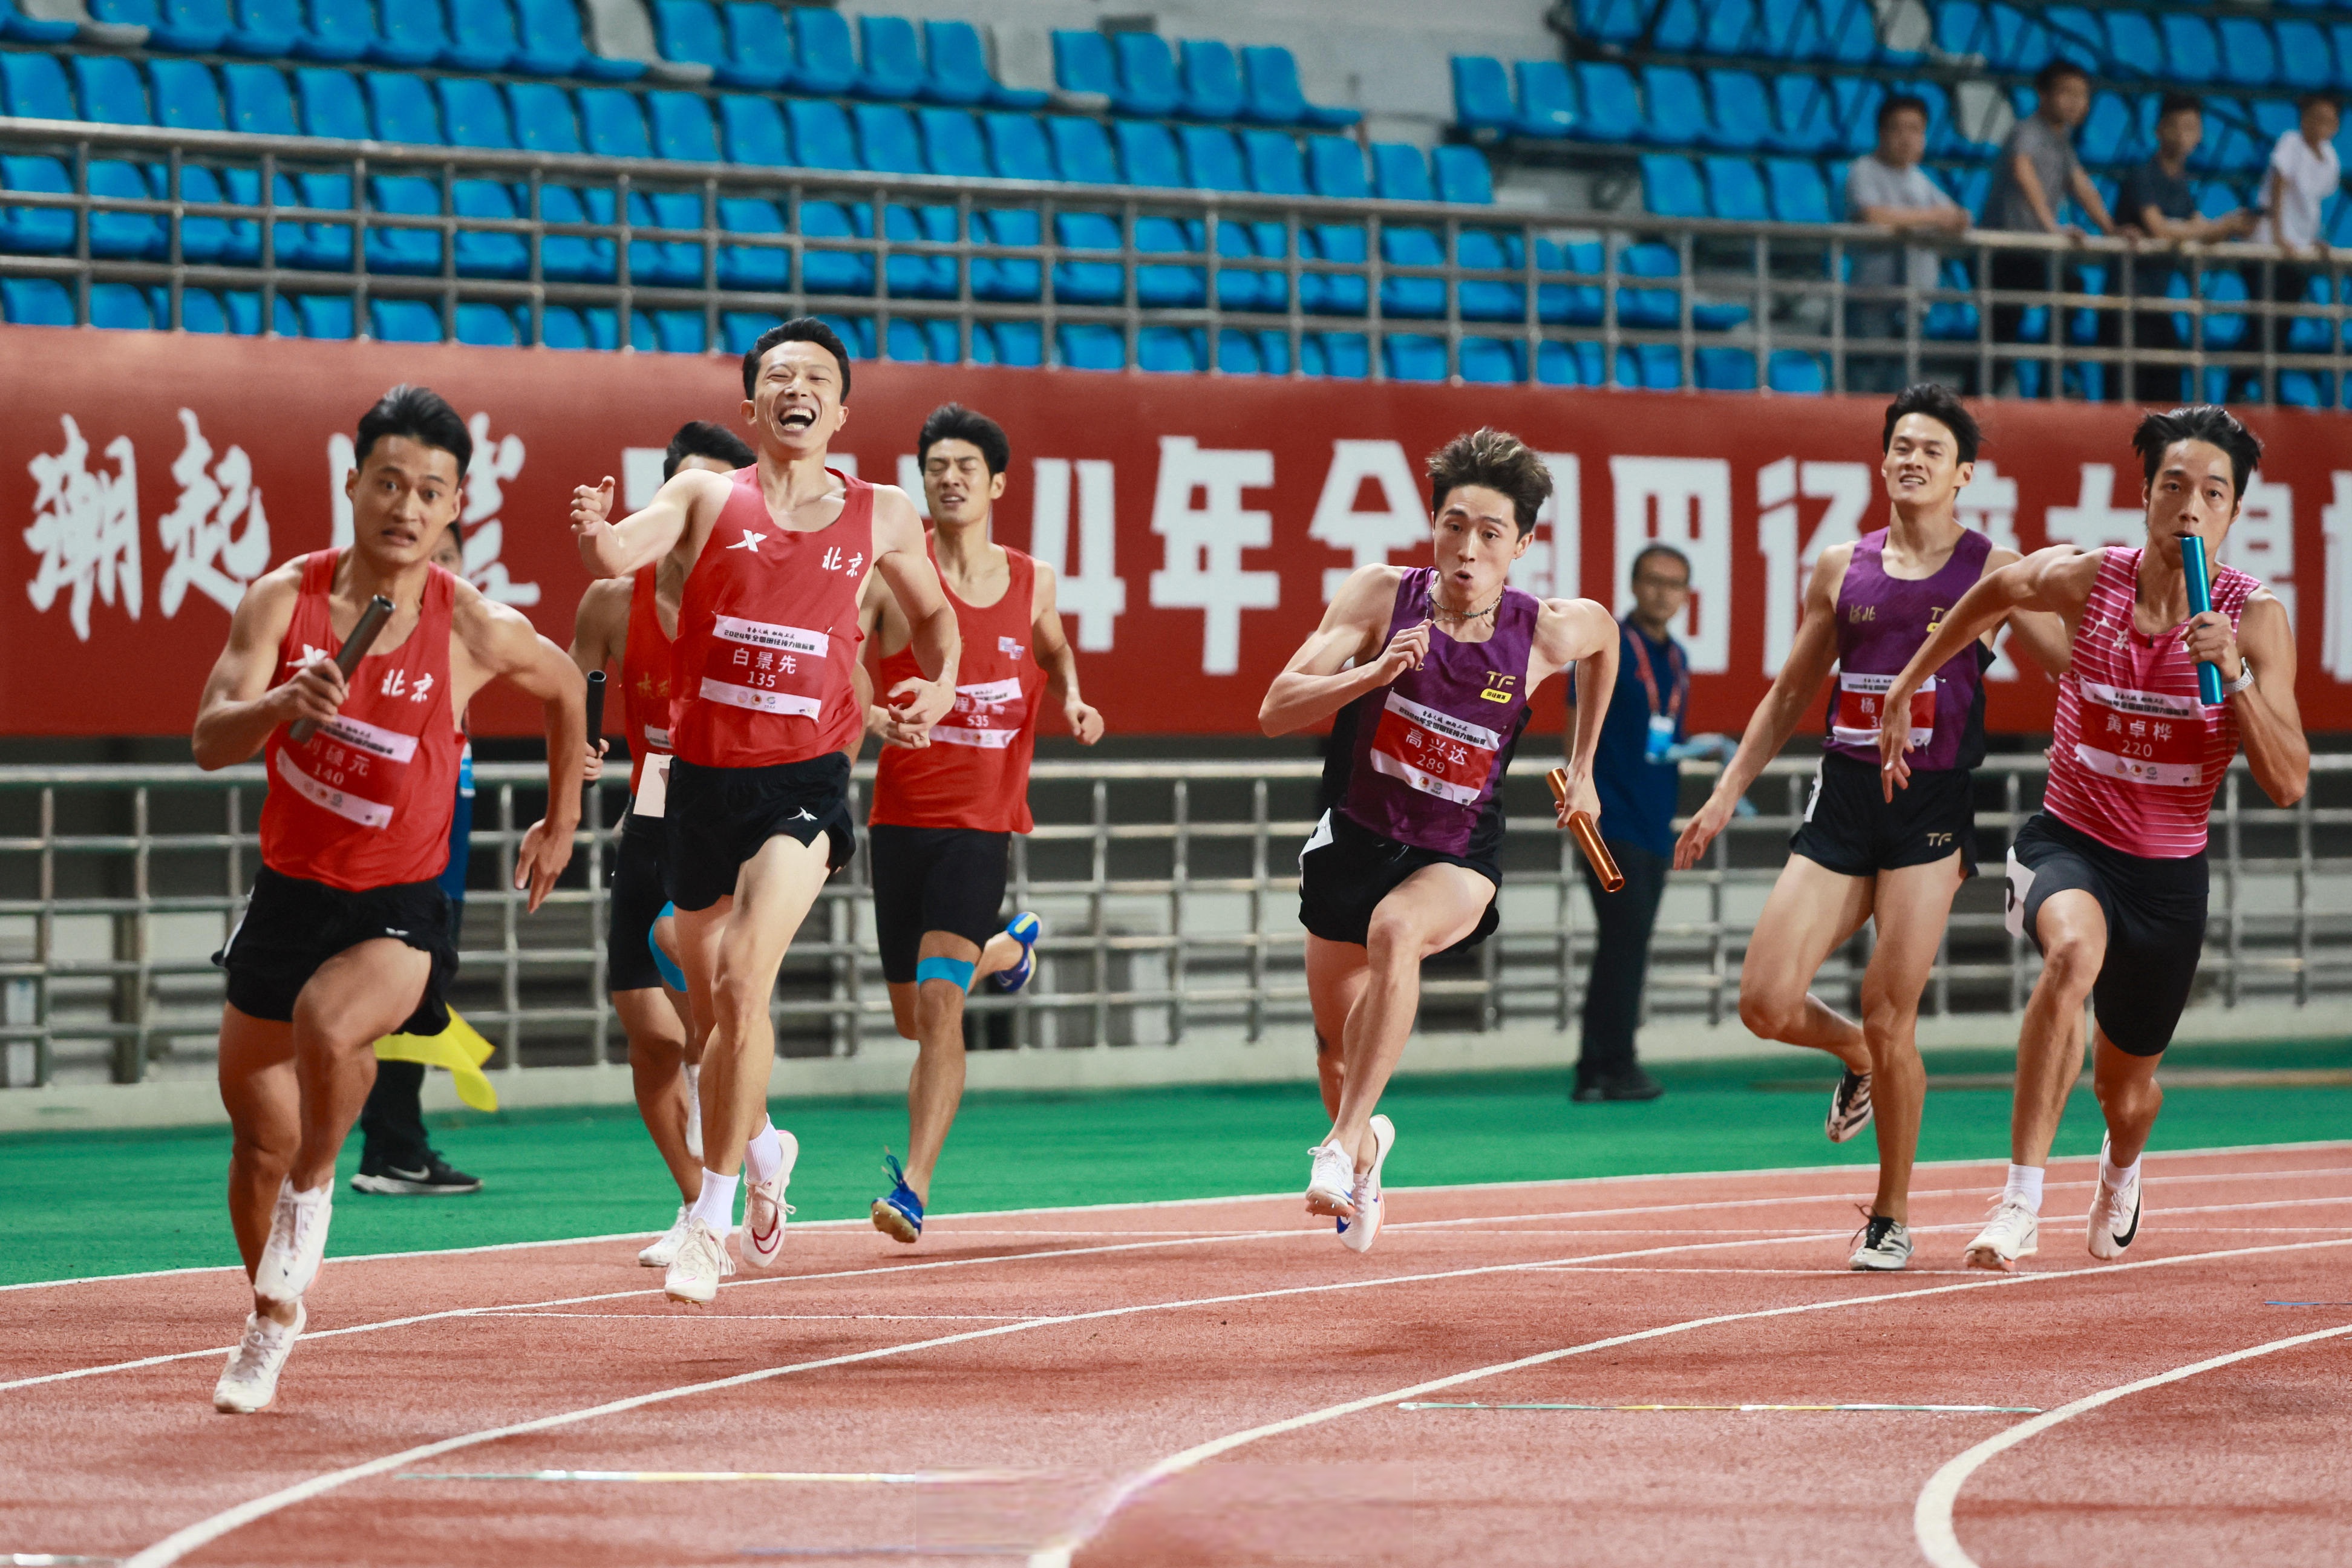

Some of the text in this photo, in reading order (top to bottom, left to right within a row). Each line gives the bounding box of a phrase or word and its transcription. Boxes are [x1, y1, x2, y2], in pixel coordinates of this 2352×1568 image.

[822, 546, 864, 577] 北京
[724, 629, 815, 652] 2024年全国田径接力锦标赛
[2087, 616, 2129, 650] 广东
[733, 647, 797, 675] 白景先
[381, 668, 434, 702] 北京
[747, 671, 776, 688] 135
[1486, 670, 1517, 688] TF
[1399, 707, 1486, 745] 2024年全国田径接力锦标赛
[2106, 713, 2173, 742] 黄卓桦
[1405, 727, 1468, 765] 高兴达
[2122, 740, 2152, 757] 220
[313, 763, 345, 786] 140
[1416, 754, 1446, 774] 289
[1926, 832, 1953, 847] TF
